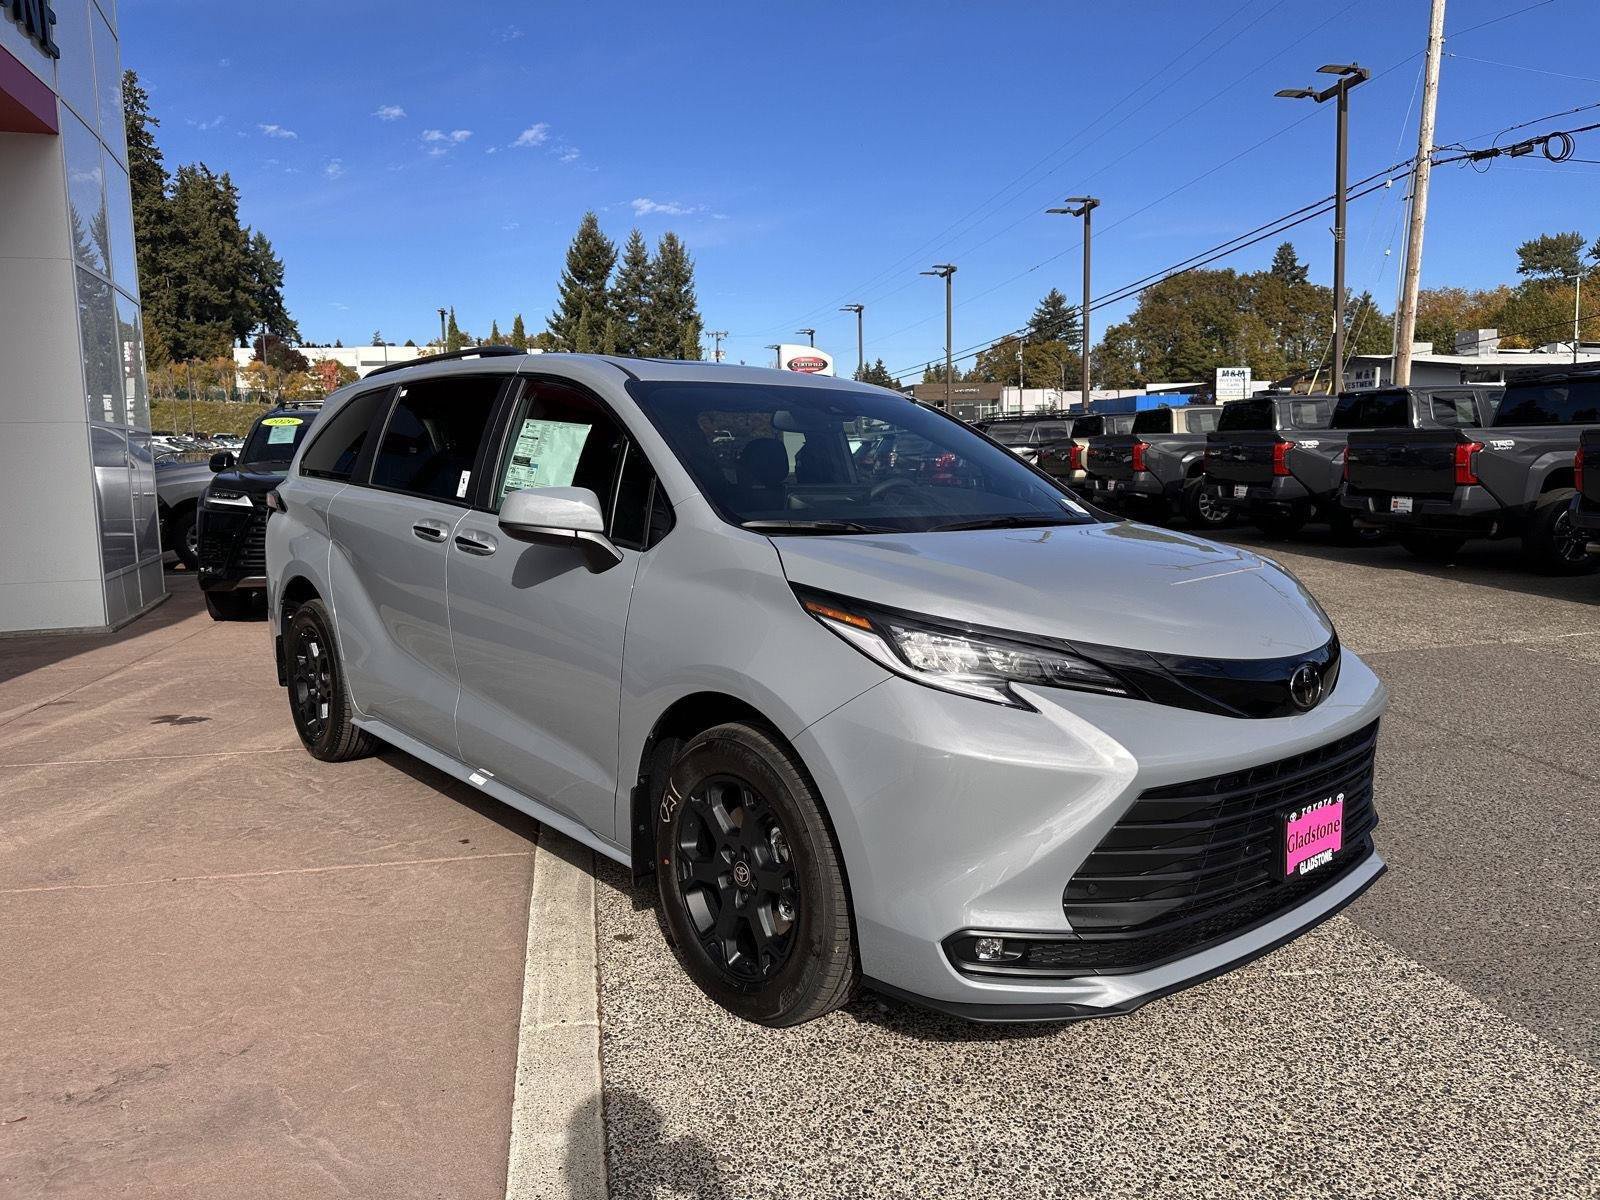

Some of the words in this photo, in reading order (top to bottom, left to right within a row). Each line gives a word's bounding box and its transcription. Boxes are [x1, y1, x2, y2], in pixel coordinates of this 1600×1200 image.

[1490, 439, 1515, 447] TRD
[1301, 797, 1332, 815] TOYOTA
[1287, 819, 1341, 853] Gladstone
[1300, 848, 1333, 876] GLADSTONE
